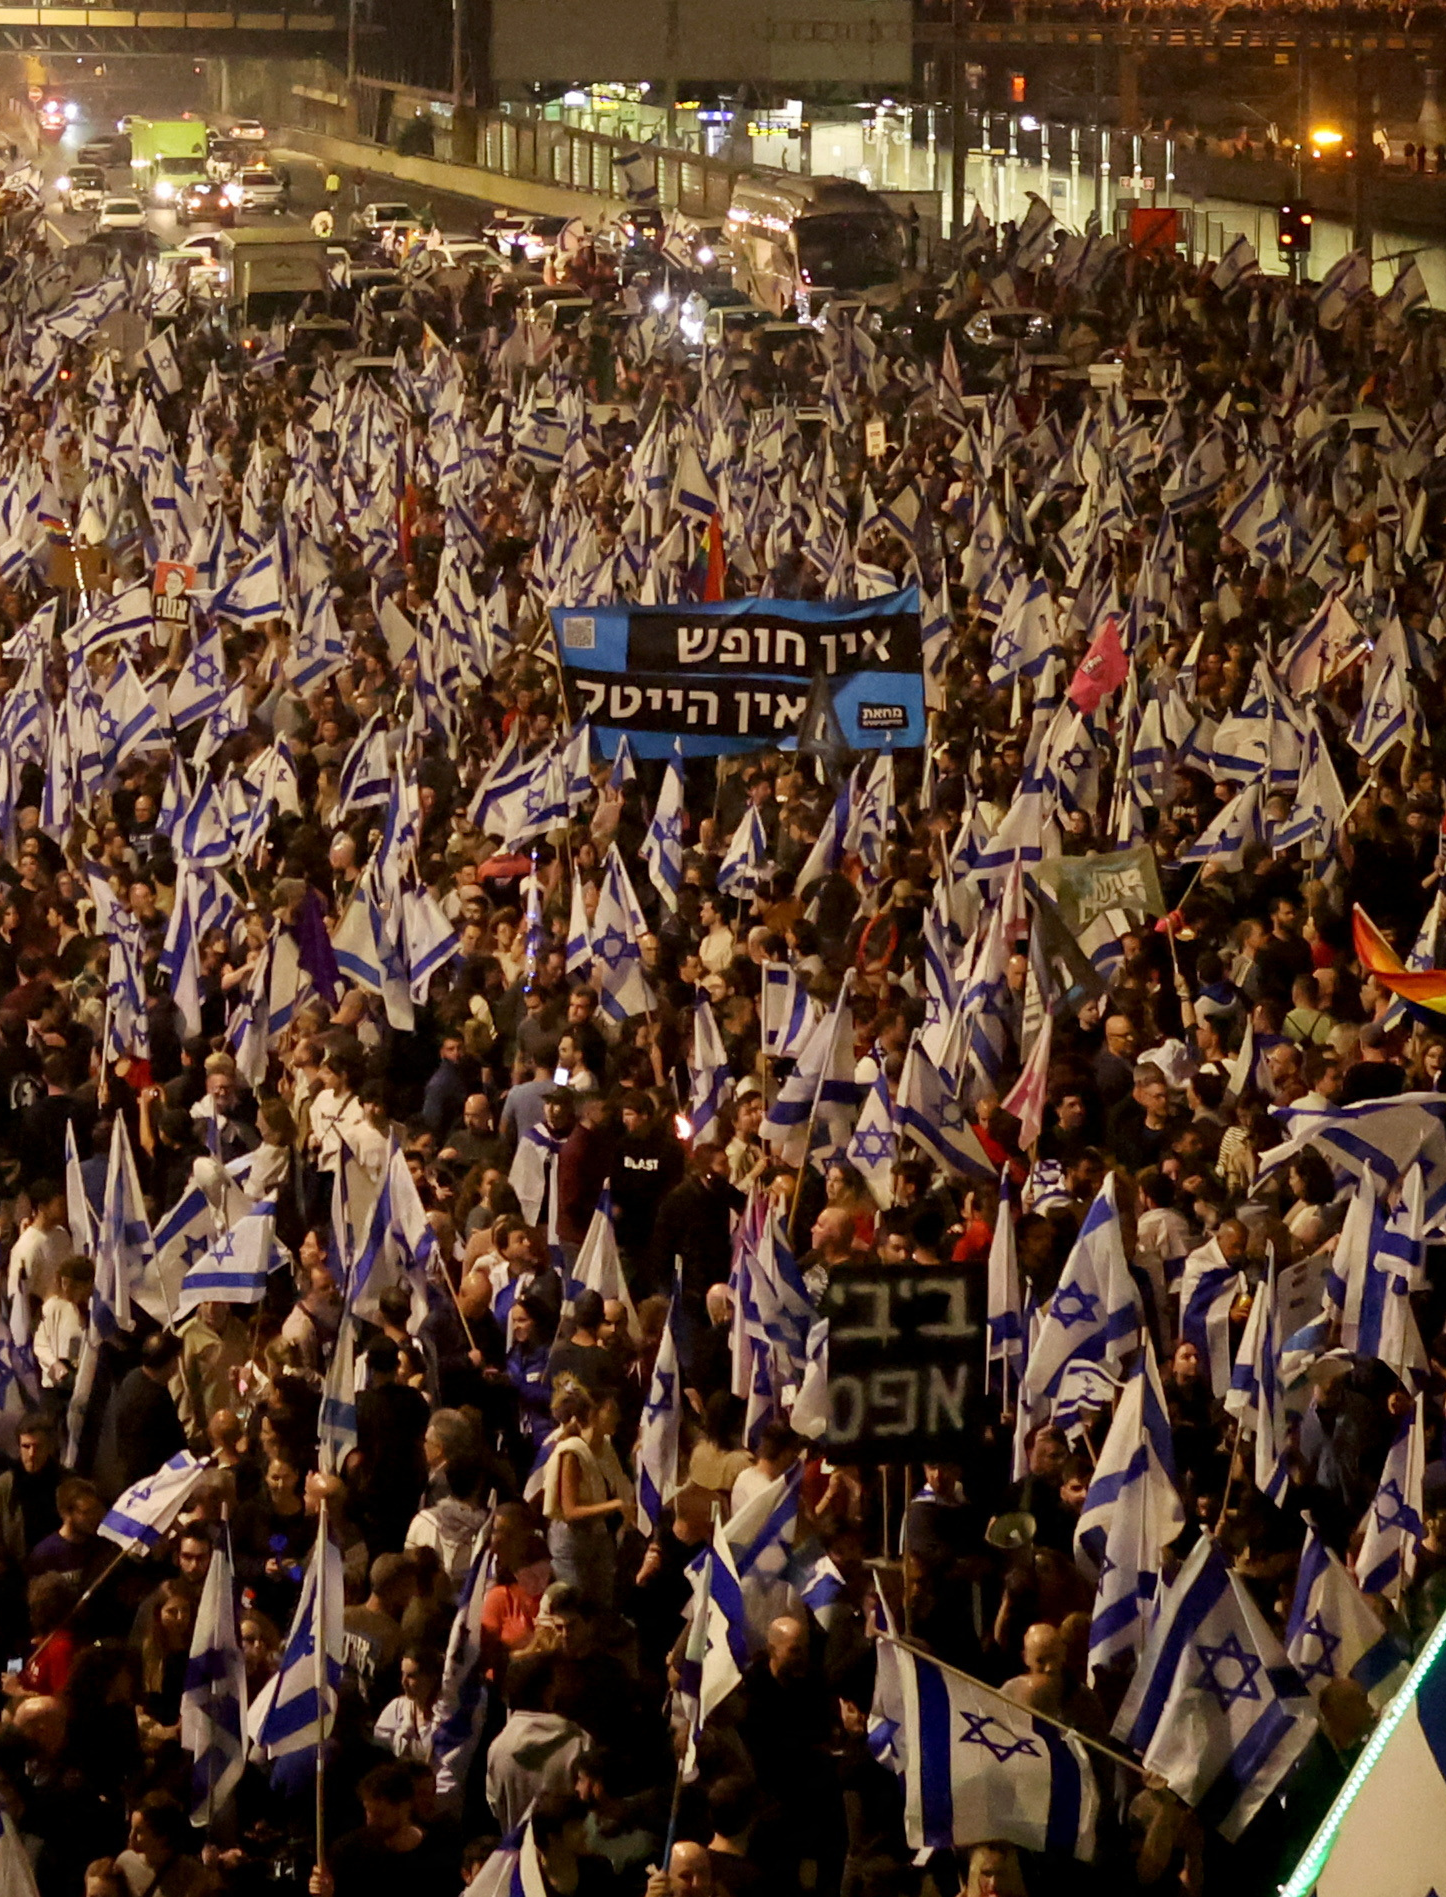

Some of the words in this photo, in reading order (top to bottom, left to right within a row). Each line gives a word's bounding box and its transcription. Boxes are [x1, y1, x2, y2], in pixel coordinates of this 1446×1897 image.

[677, 627, 807, 666] חופש
[819, 628, 892, 675] אין
[575, 678, 720, 725] הייטק
[734, 690, 809, 735] אין
[862, 707, 903, 720] מחאת
[825, 1364, 968, 1446] אפס
